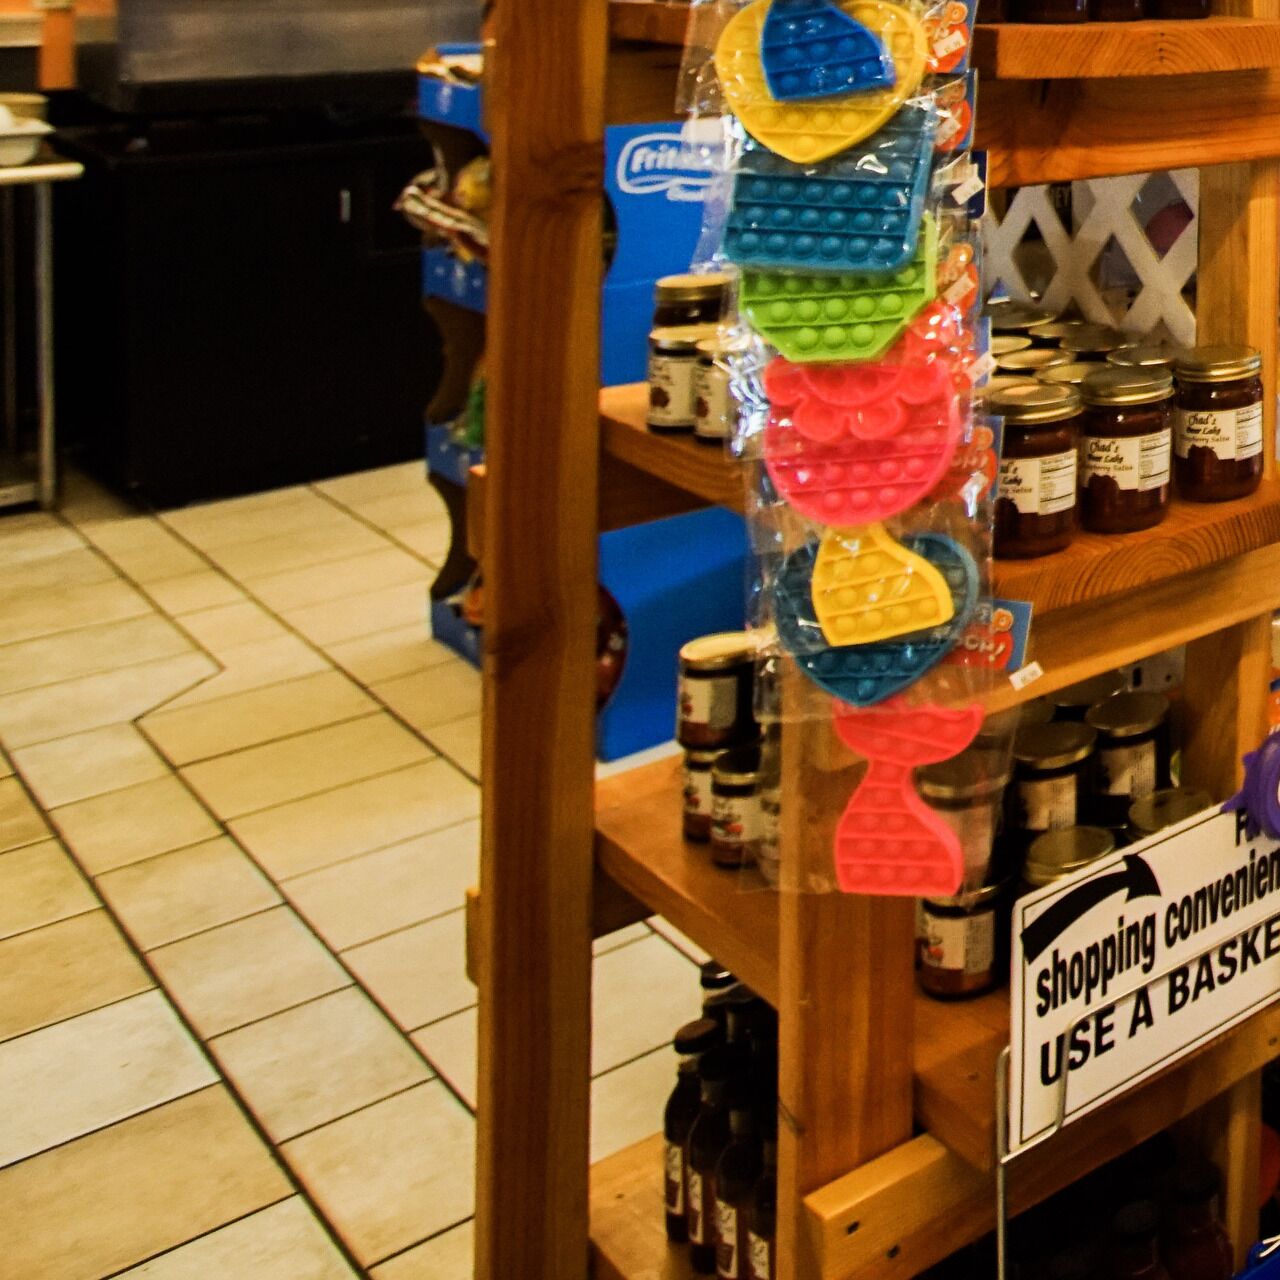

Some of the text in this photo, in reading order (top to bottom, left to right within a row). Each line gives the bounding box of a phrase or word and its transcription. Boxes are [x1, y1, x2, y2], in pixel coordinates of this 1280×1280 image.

[1036, 913, 1156, 1018] shopping
[1040, 1006, 1115, 1086] USE
[1128, 986, 1154, 1038] A
